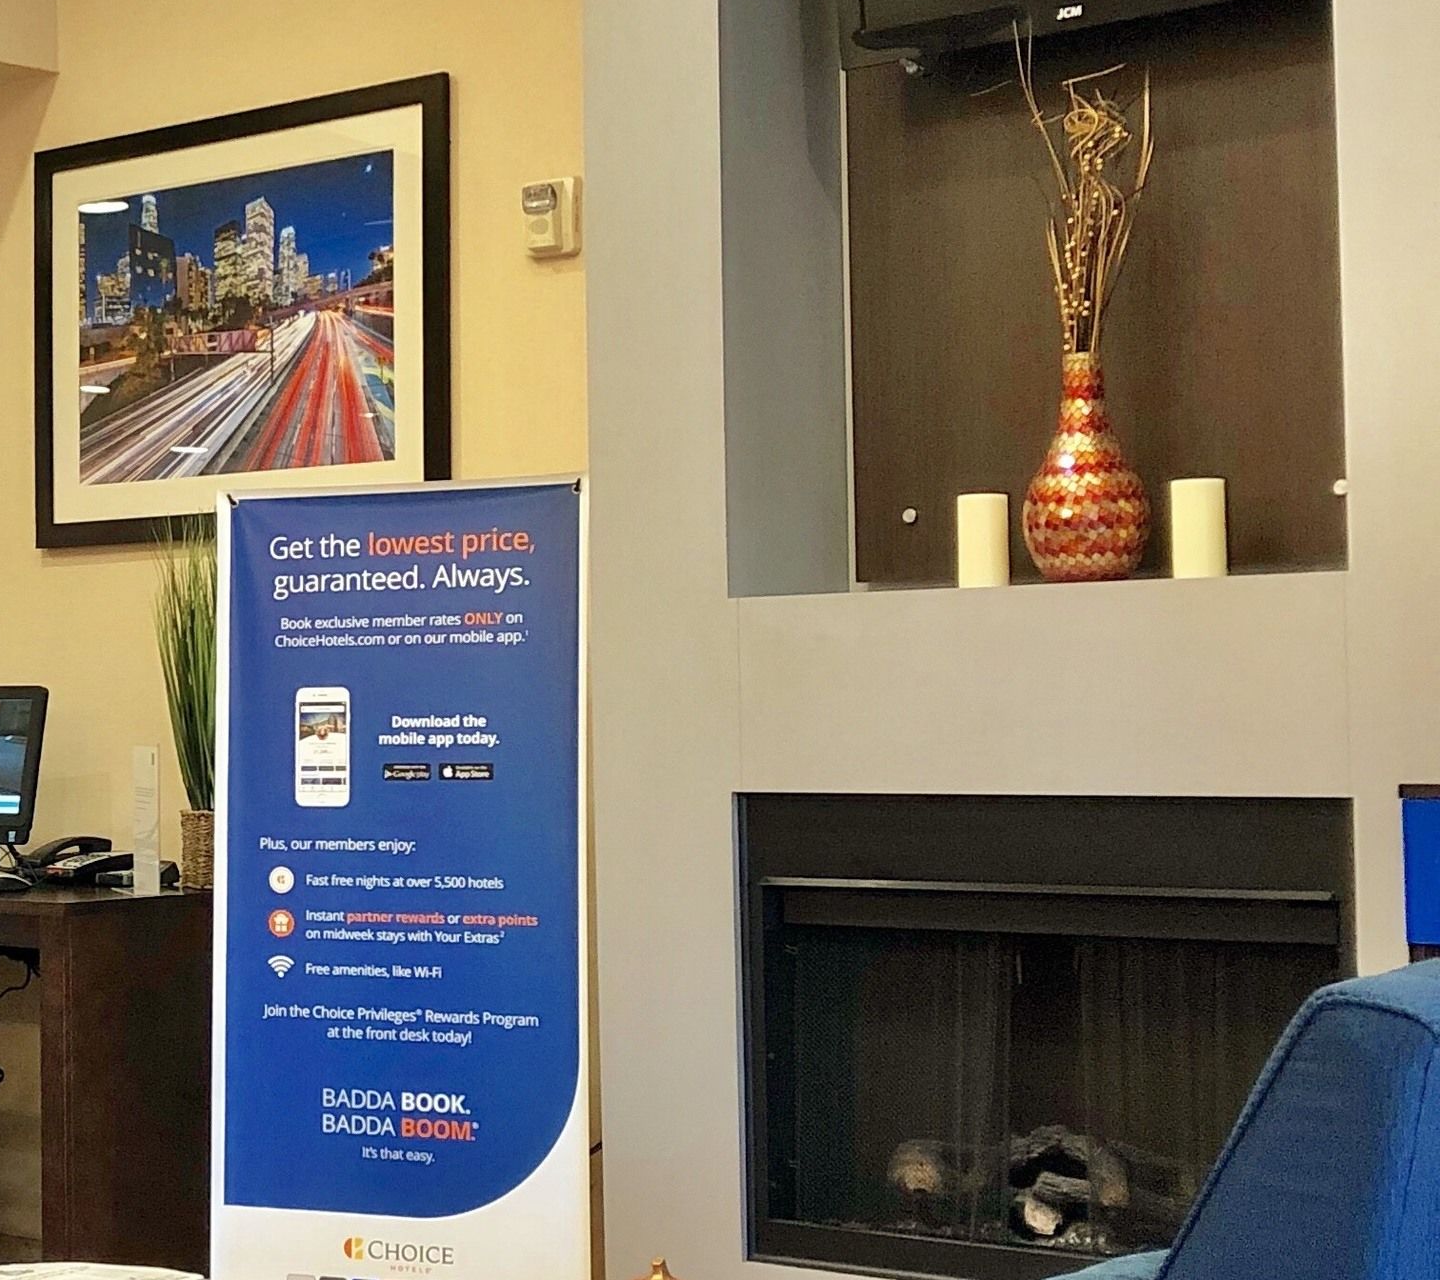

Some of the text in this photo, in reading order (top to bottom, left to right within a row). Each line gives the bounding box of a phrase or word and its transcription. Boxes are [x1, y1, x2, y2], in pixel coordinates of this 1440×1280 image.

[270, 527, 536, 560] Get the lowest price,
[273, 563, 530, 600] guaranteed. Always.
[280, 612, 523, 630] Book exclusive member rates ONLY on
[274, 633, 385, 648] ChoiceHotels.com
[387, 635, 402, 645] or
[404, 634, 421, 645] on
[423, 634, 447, 645] our
[449, 630, 494, 643] mobile
[391, 714, 487, 728] Download the
[378, 731, 500, 748] mobile app today.
[259, 837, 417, 855] Plus, our members enjoy:
[306, 874, 504, 890] Fast free nights at over 5,500 hotels
[306, 910, 539, 928] Instant partner rewards or extra points
[306, 930, 321, 939] on
[323, 928, 374, 941] midweek
[376, 930, 406, 944] stays
[407, 930, 433, 942] with
[434, 931, 462, 943] Your
[305, 963, 442, 979] Free amenities, like Wi-Fi
[262, 1004, 287, 1019] Join
[289, 1005, 310, 1018] the
[312, 1005, 355, 1020] Choice
[425, 1009, 480, 1024] Rewards
[482, 1012, 540, 1029] Program
[327, 1026, 473, 1047] at the front desk today!
[322, 1088, 471, 1115] BADDA BOOK.
[322, 1113, 396, 1137] BADDA
[361, 1146, 436, 1165] It's that easy.
[367, 1240, 454, 1265] CHOICE
